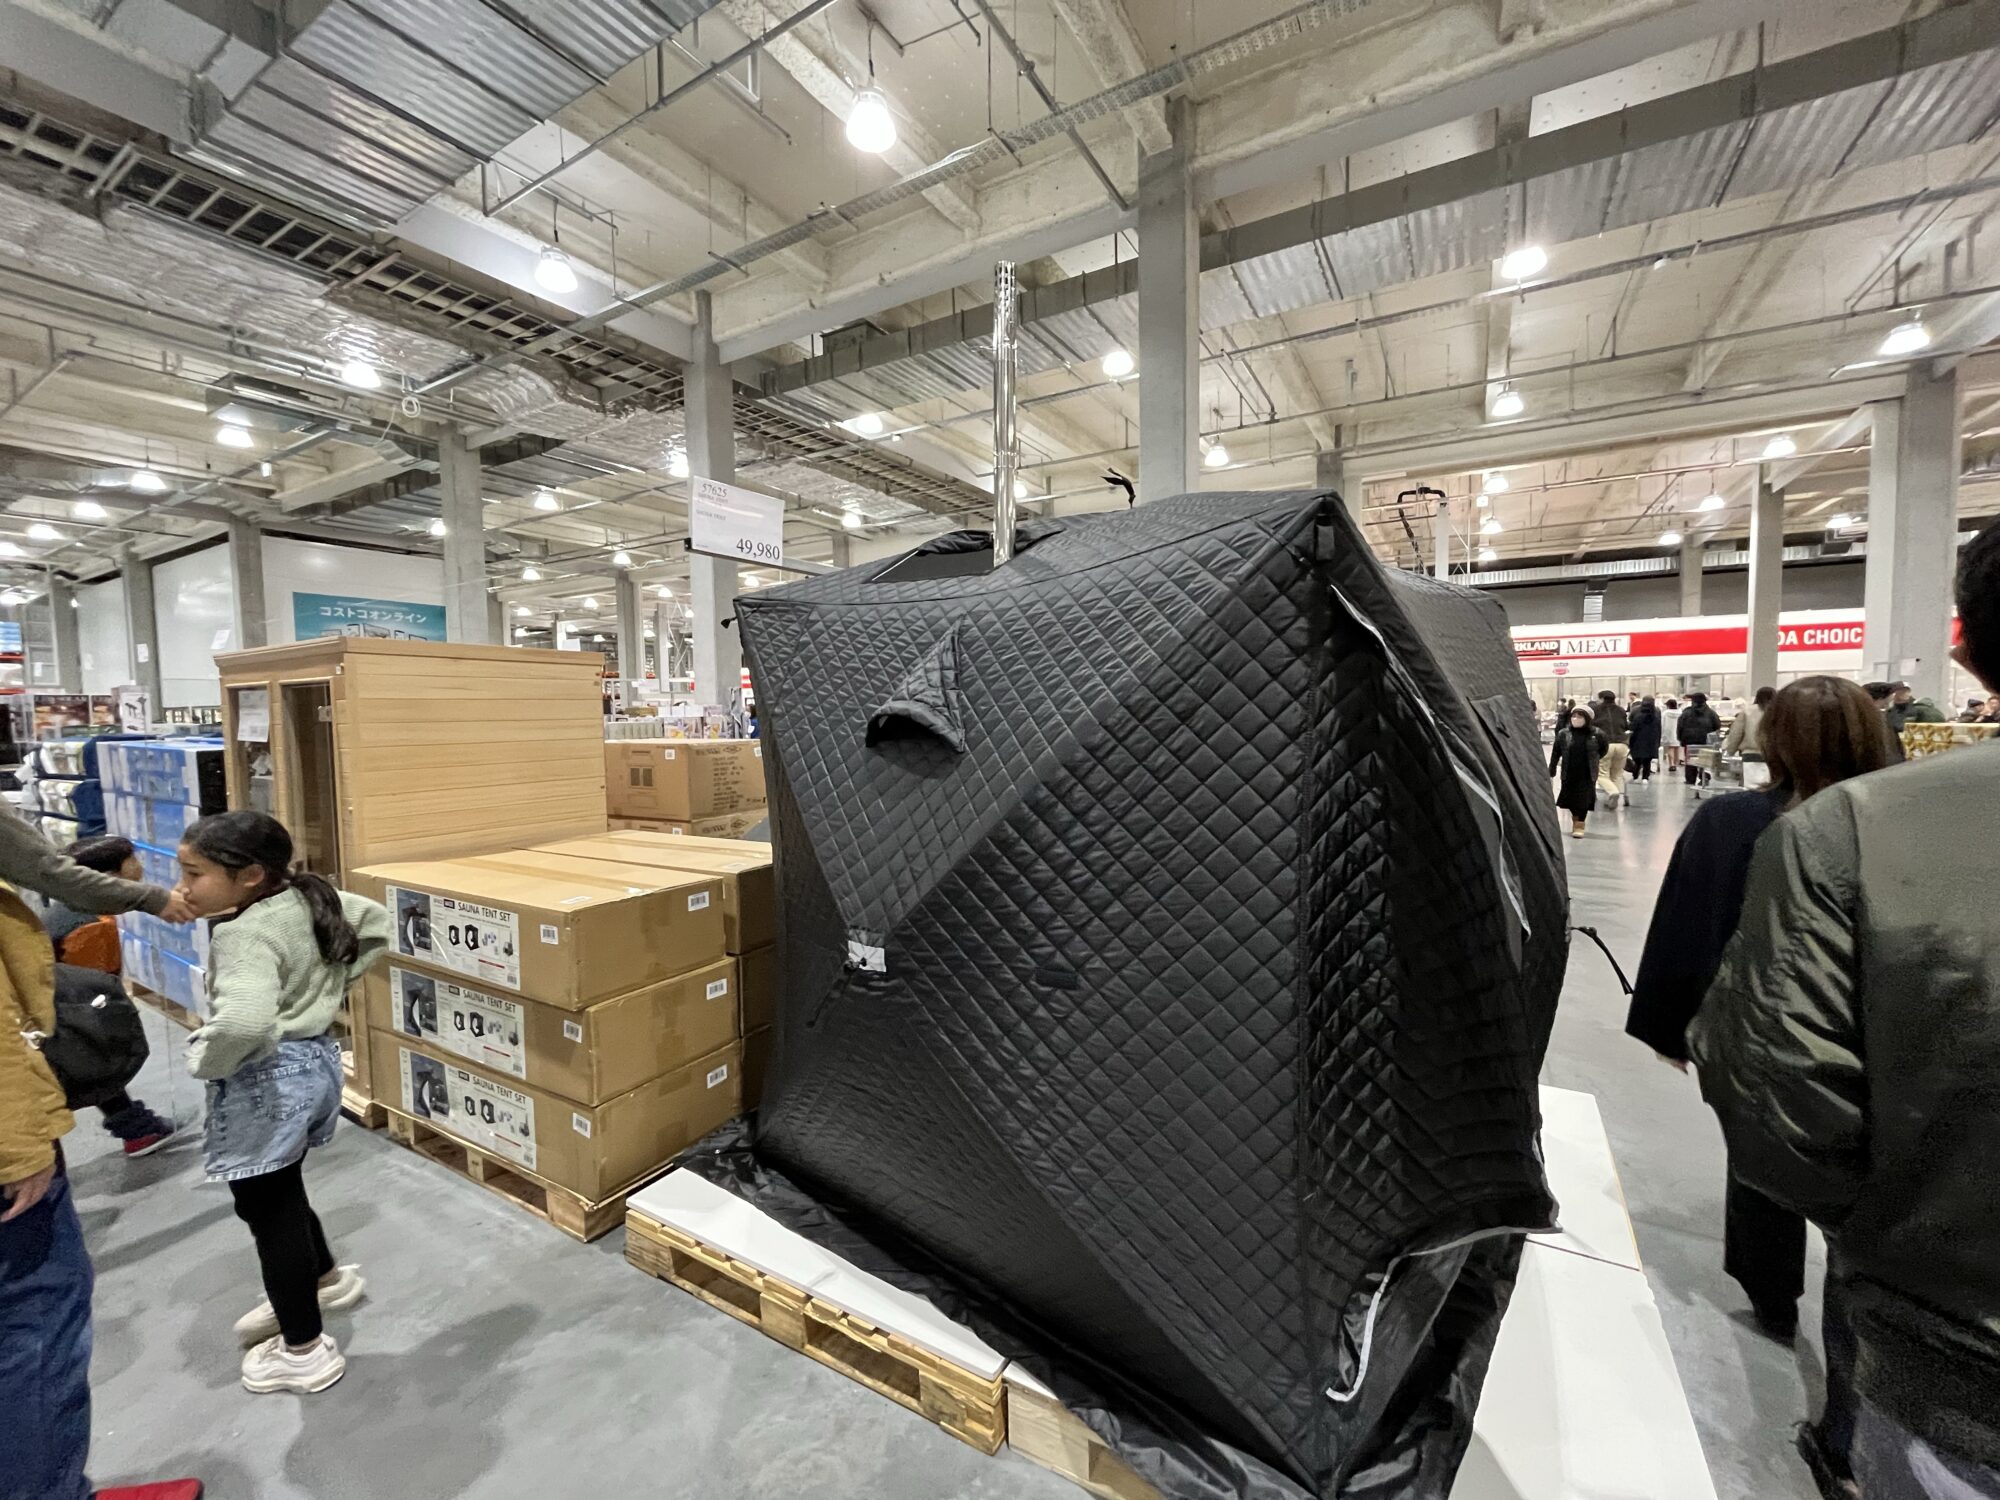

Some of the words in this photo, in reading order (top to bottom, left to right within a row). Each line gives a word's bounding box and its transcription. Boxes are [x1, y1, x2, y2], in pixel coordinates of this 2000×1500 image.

[702, 483, 728, 497] 57625
[736, 538, 780, 561] 49,980
[319, 606, 427, 623] コストコオンライン
[1566, 639, 1622, 654] MEAT
[458, 902, 480, 915] SAUNA
[481, 907, 498, 919] TENT
[499, 911, 511, 922] SET
[463, 989, 485, 1003] SAUNA
[486, 994, 503, 1009] TENT
[504, 1000, 516, 1013] SET
[472, 1076, 495, 1092] SAUNA
[496, 1084, 513, 1099] TENT
[514, 1092, 526, 1104] SET
